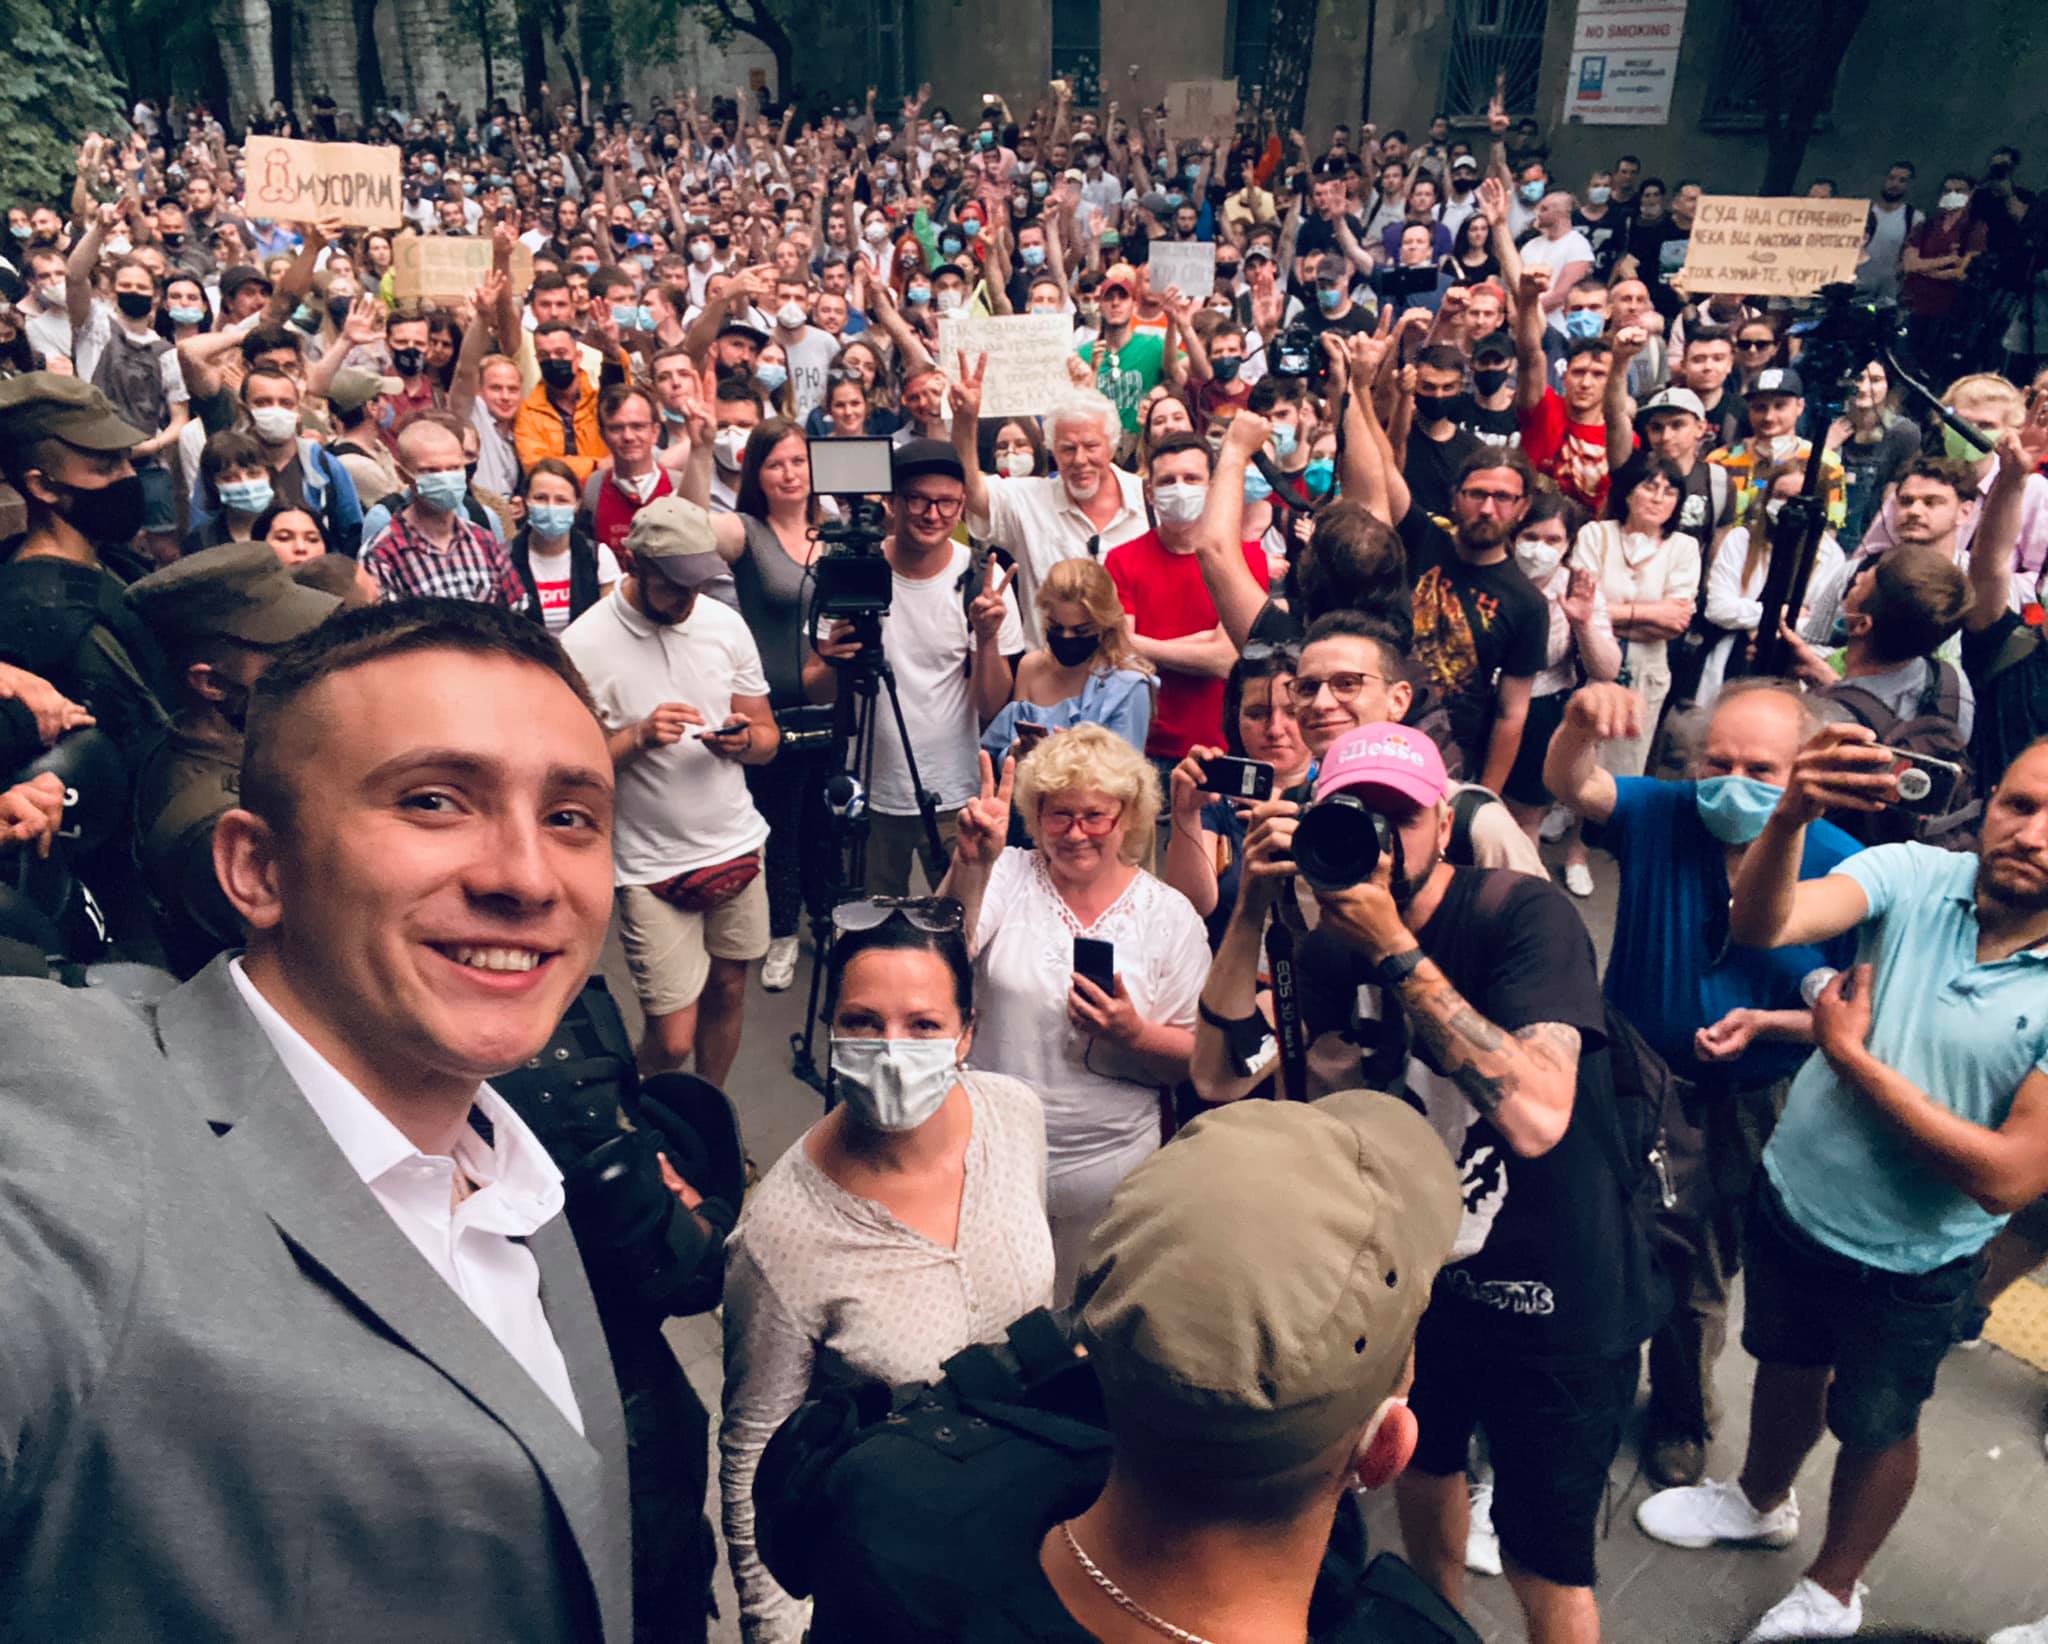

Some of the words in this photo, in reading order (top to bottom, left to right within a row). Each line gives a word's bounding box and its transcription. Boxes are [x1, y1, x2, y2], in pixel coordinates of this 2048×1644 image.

[1585, 25, 1604, 38] NO
[1607, 23, 1672, 38] SMOKING
[297, 173, 394, 210] МУСОРАМ
[1701, 204, 1737, 224] СУД
[1743, 207, 1772, 226] НАД
[1276, 960, 1293, 998] EOS
